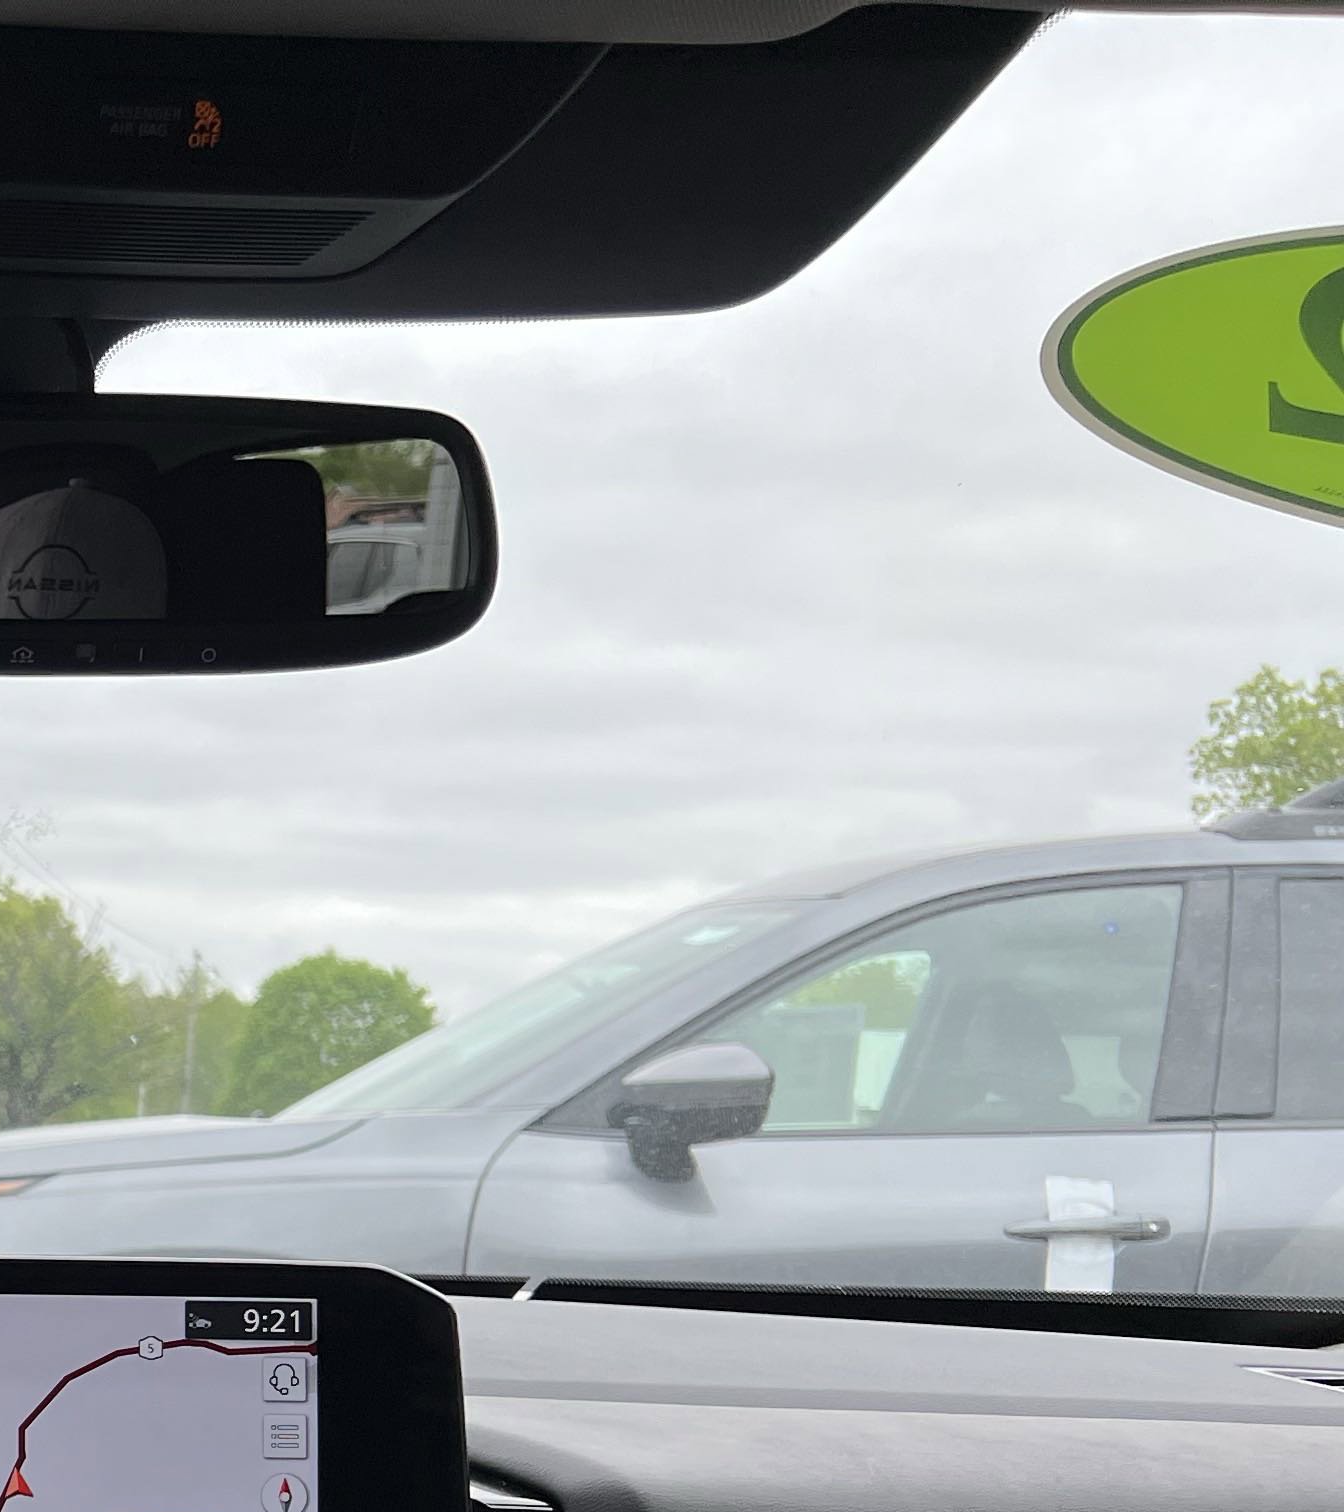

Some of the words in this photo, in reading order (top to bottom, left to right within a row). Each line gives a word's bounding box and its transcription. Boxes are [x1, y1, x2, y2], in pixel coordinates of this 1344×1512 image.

[187, 133, 221, 148] OFF
[243, 1308, 300, 1333] 9:21
[147, 1343, 155, 1353] 5
